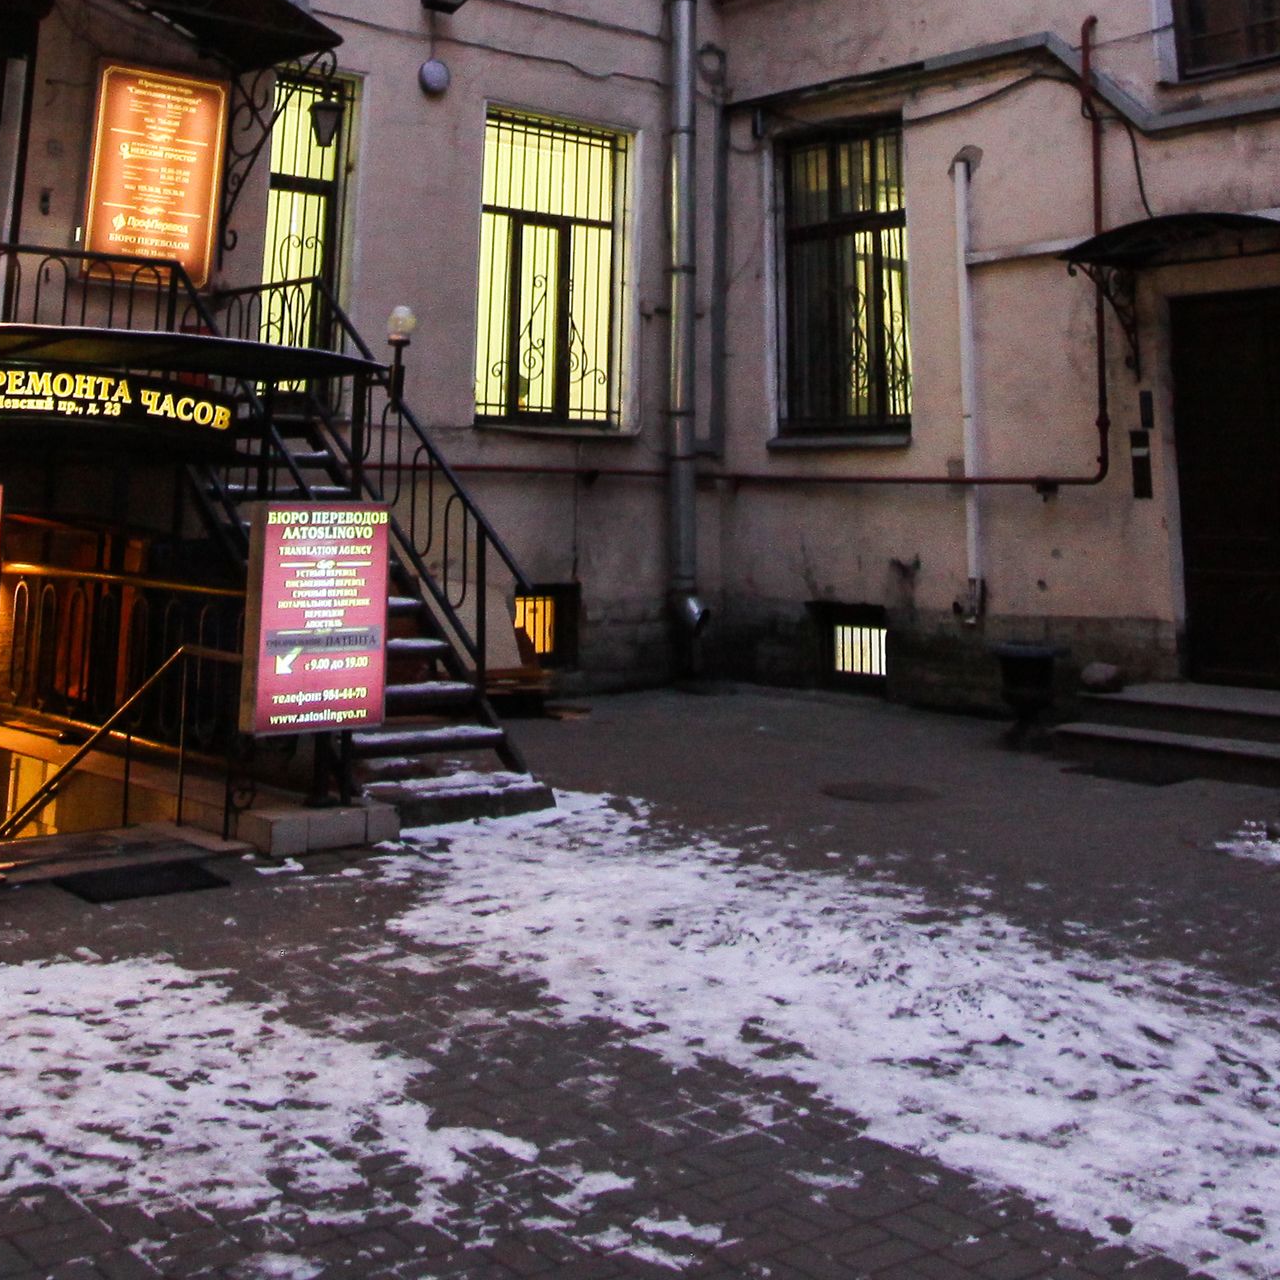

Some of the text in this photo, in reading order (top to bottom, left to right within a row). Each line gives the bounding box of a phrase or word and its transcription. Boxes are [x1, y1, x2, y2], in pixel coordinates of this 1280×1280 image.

[108, 232, 136, 244] БЮРО
[137, 236, 190, 249] ПЕРЕВОДОВ
[104, 402, 122, 417] 23
[140, 389, 231, 430] ЧАСОВ
[268, 511, 389, 526] БЮРО ПЕРЕВОДОВ
[282, 526, 374, 540] AATOSLINGVO
[279, 545, 372, 556] TRANSLATION AGENCY
[326, 634, 377, 646] ПАТЕНТА
[311, 659, 330, 670] 9.00
[330, 660, 344, 671] до
[345, 656, 369, 669] 19.00
[272, 691, 322, 706] телефон:
[269, 708, 367, 725] www.aatoslingvo.ru
